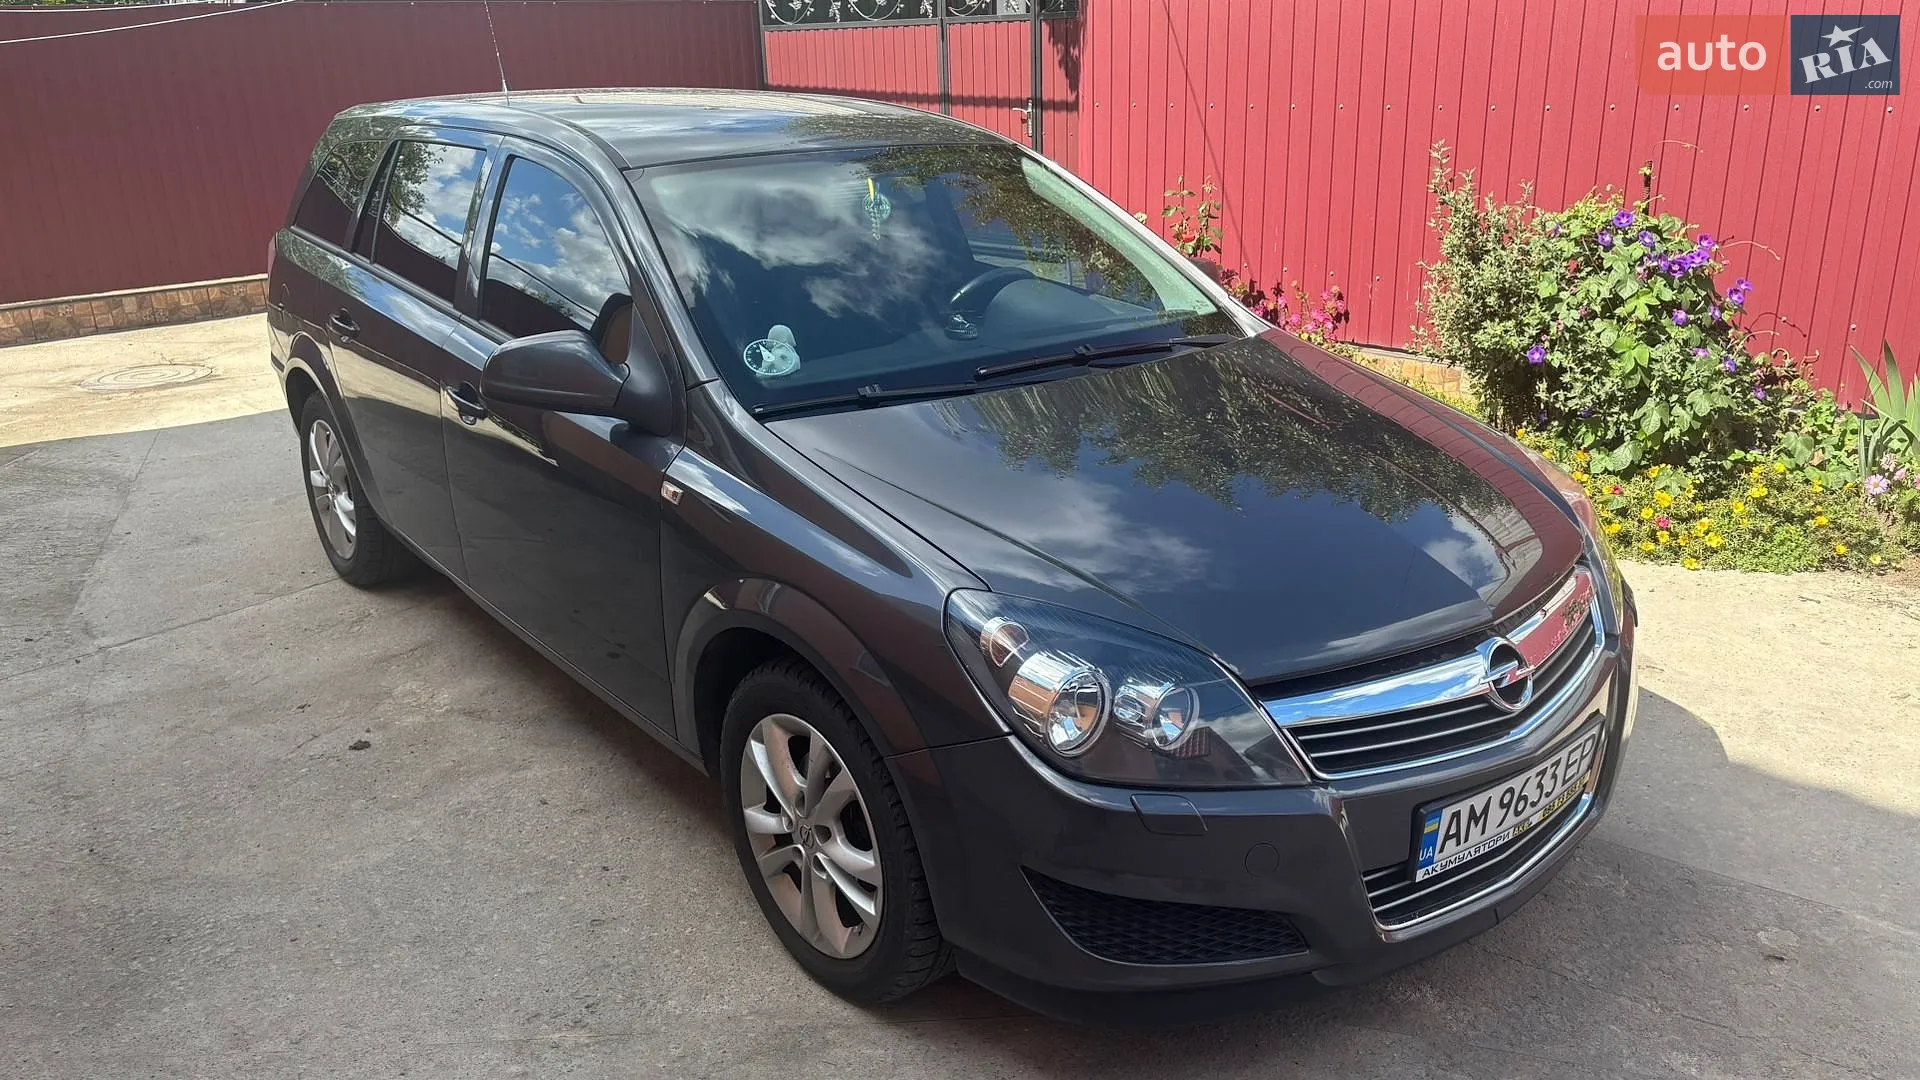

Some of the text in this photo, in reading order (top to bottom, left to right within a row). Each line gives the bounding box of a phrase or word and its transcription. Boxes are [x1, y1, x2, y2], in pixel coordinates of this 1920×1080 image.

[1438, 795, 1493, 854] AM
[1496, 757, 1562, 829] 9633
[1561, 733, 1598, 788] EP
[1419, 846, 1433, 861] UA
[1421, 832, 1510, 878] АКУМУЛЯТОРИ
